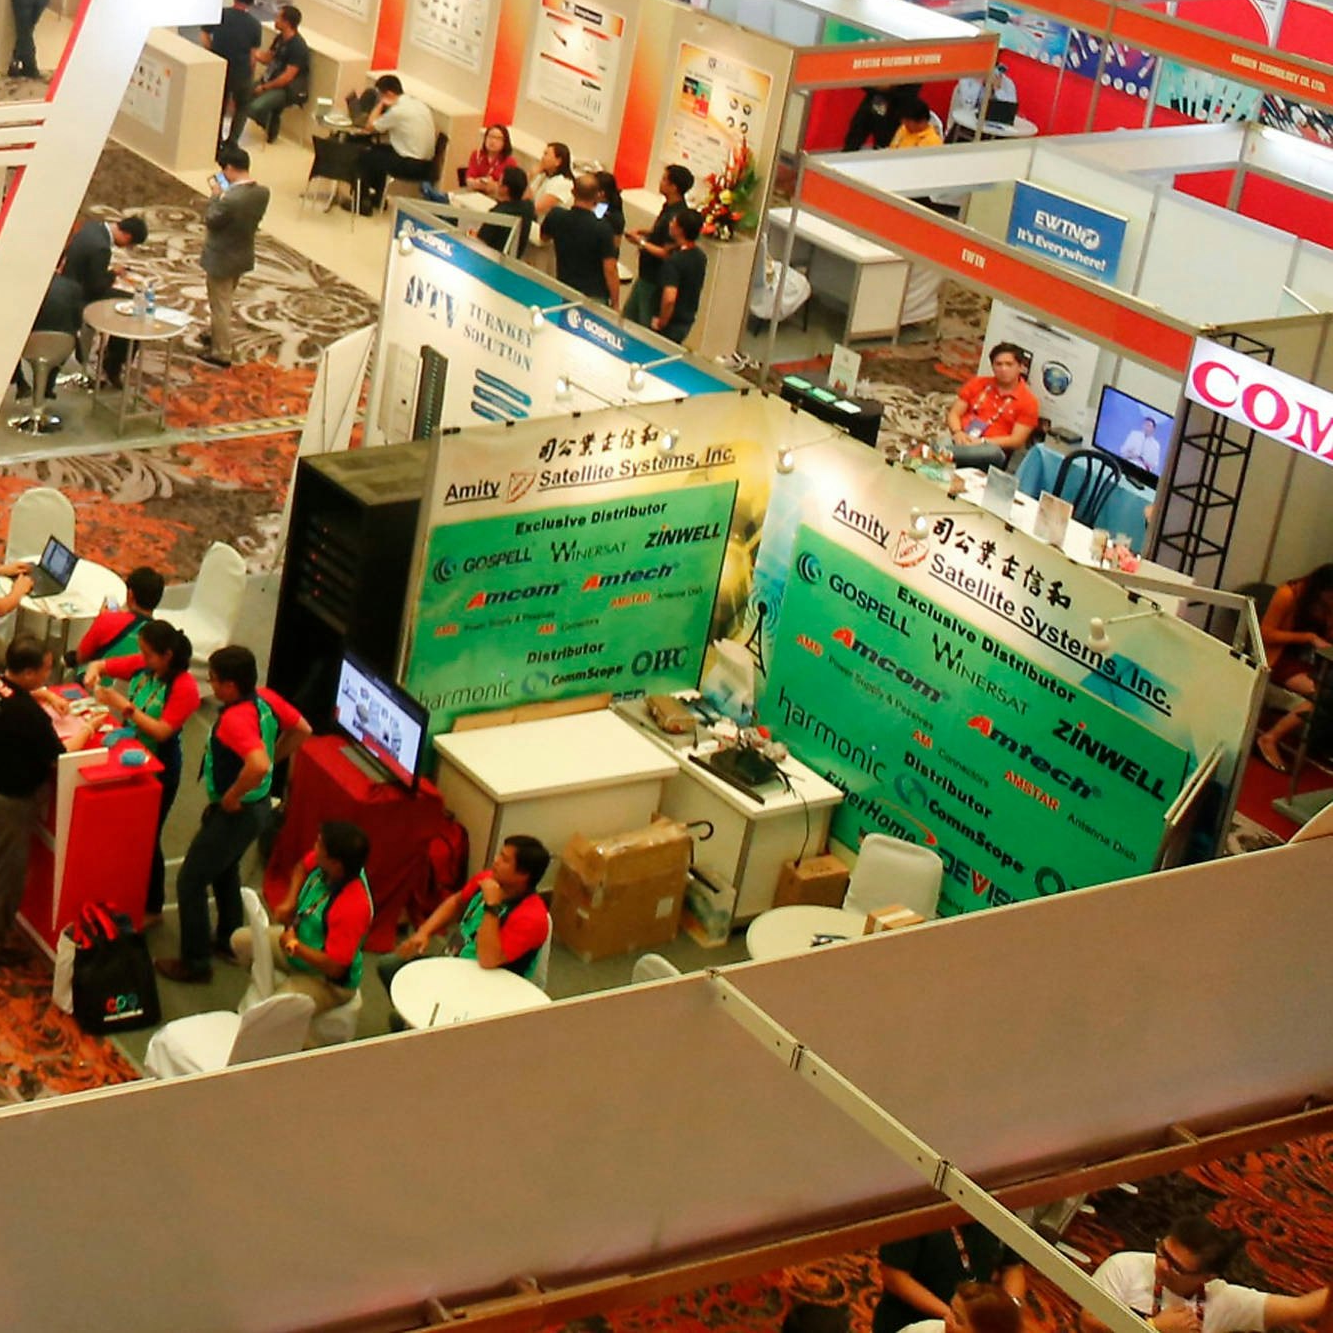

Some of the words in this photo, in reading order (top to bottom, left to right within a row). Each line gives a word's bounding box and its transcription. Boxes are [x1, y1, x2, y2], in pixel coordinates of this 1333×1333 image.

[1035, 210, 1082, 239] EWTN
[962, 247, 986, 269] EWTN
[1017, 226, 1033, 244] It's
[1036, 233, 1107, 273] Everywhere!
[405, 273, 458, 329] DTV
[463, 324, 532, 372] SOLUTION
[468, 302, 532, 349] TURNKEY
[584, 318, 625, 351] GOSPELL
[445, 479, 501, 502] Amity
[539, 468, 614, 488] Satellite
[620, 450, 699, 477] Systems,
[706, 446, 736, 465] Inc.
[515, 514, 586, 536] Exclusive
[591, 502, 667, 523] Distributor
[463, 547, 532, 573] GOSPELL
[466, 583, 559, 609] Amcom
[583, 564, 672, 591] Amtech
[611, 592, 651, 608] AMSTAR
[829, 573, 911, 638] GOSPELL
[833, 498, 891, 546] Amity
[931, 552, 1016, 618] Satellite
[1021, 605, 1123, 684] Systems,
[1130, 665, 1172, 710] Inc.
[538, 623, 556, 634] AM
[897, 584, 977, 644] Exclusive
[981, 636, 1077, 704] Distributor
[526, 642, 605, 664] Distributor
[418, 677, 516, 712] harmonic
[551, 664, 623, 687] CommScope
[777, 685, 887, 784] harmonic
[832, 627, 942, 703] Amcom
[967, 715, 1093, 800] Amtech
[854, 670, 884, 697] Supply
[912, 728, 933, 750] AM
[1004, 769, 1061, 812] AMSTAR
[1068, 813, 1110, 846] Antenna
[1112, 839, 1137, 863] Dish
[903, 751, 994, 818] Distributor
[928, 797, 1025, 874] CommScope
